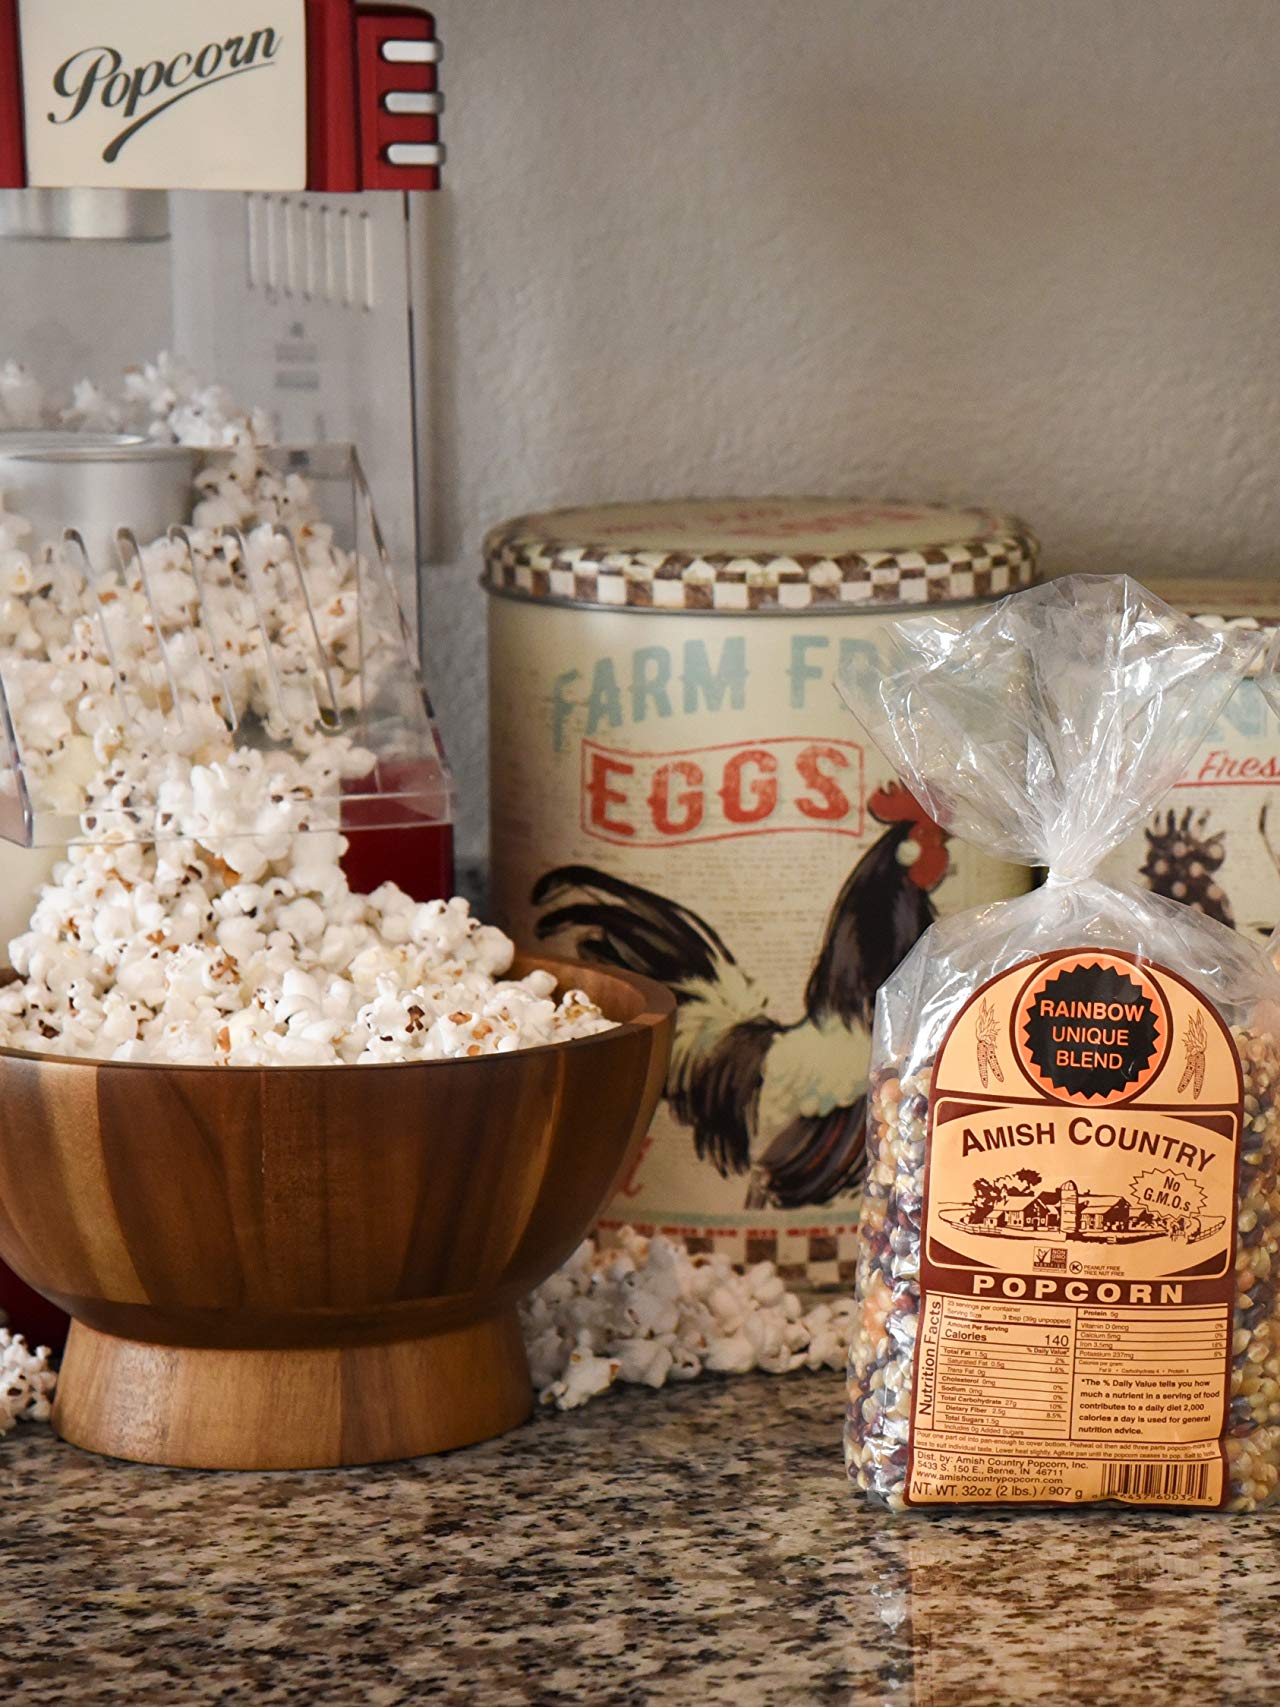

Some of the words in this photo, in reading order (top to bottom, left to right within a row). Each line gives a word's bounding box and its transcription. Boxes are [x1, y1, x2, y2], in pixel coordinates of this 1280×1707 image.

[47, 27, 283, 124] Popcorn
[553, 636, 750, 752] FARM
[587, 745, 849, 836] EGGS
[1040, 1001, 1144, 1022] RAINBOW
[1052, 1027, 1128, 1046] UNIQUE
[1057, 1052, 1123, 1069] BLEND
[973, 1275, 1183, 1304] POPCORN
[924, 1301, 941, 1344] Facts
[947, 1321, 970, 1329] Amount
[984, 1325, 1008, 1333] Serving
[945, 1329, 986, 1341] Calories
[1045, 1335, 1069, 1346] 140
[919, 1348, 935, 1416] Nutrition
[1113, 1380, 1132, 1388] Daily
[1163, 1393, 1191, 1401] serving
[1080, 1403, 1125, 1411] contributes
[1146, 1404, 1164, 1412] daily
[1184, 1404, 1204, 1412] 2,000
[1121, 1416, 1134, 1424] day
[1183, 1416, 1210, 1424] general
[918, 1451, 935, 1461] Dist.
[940, 1452, 953, 1463] by:
[956, 1456, 984, 1465] Amish
[988, 1458, 1024, 1468] Country
[1028, 1460, 1068, 1469] Popcorn,
[1072, 1461, 1088, 1469] Inc.
[918, 1460, 937, 1470] 5433
[941, 1464, 949, 1472] S.
[954, 1465, 968, 1473] 150
[987, 1468, 1016, 1476] Berne,
[917, 1471, 1062, 1484] www.amishcountrypopcorn.com
[913, 1481, 932, 1496] NT.
[936, 1484, 958, 1497] WT.
[962, 1486, 991, 1497] 32oz
[996, 1486, 1007, 1498] (2
[1012, 1486, 1037, 1498] lbs.)
[1049, 1486, 1071, 1495] 907
